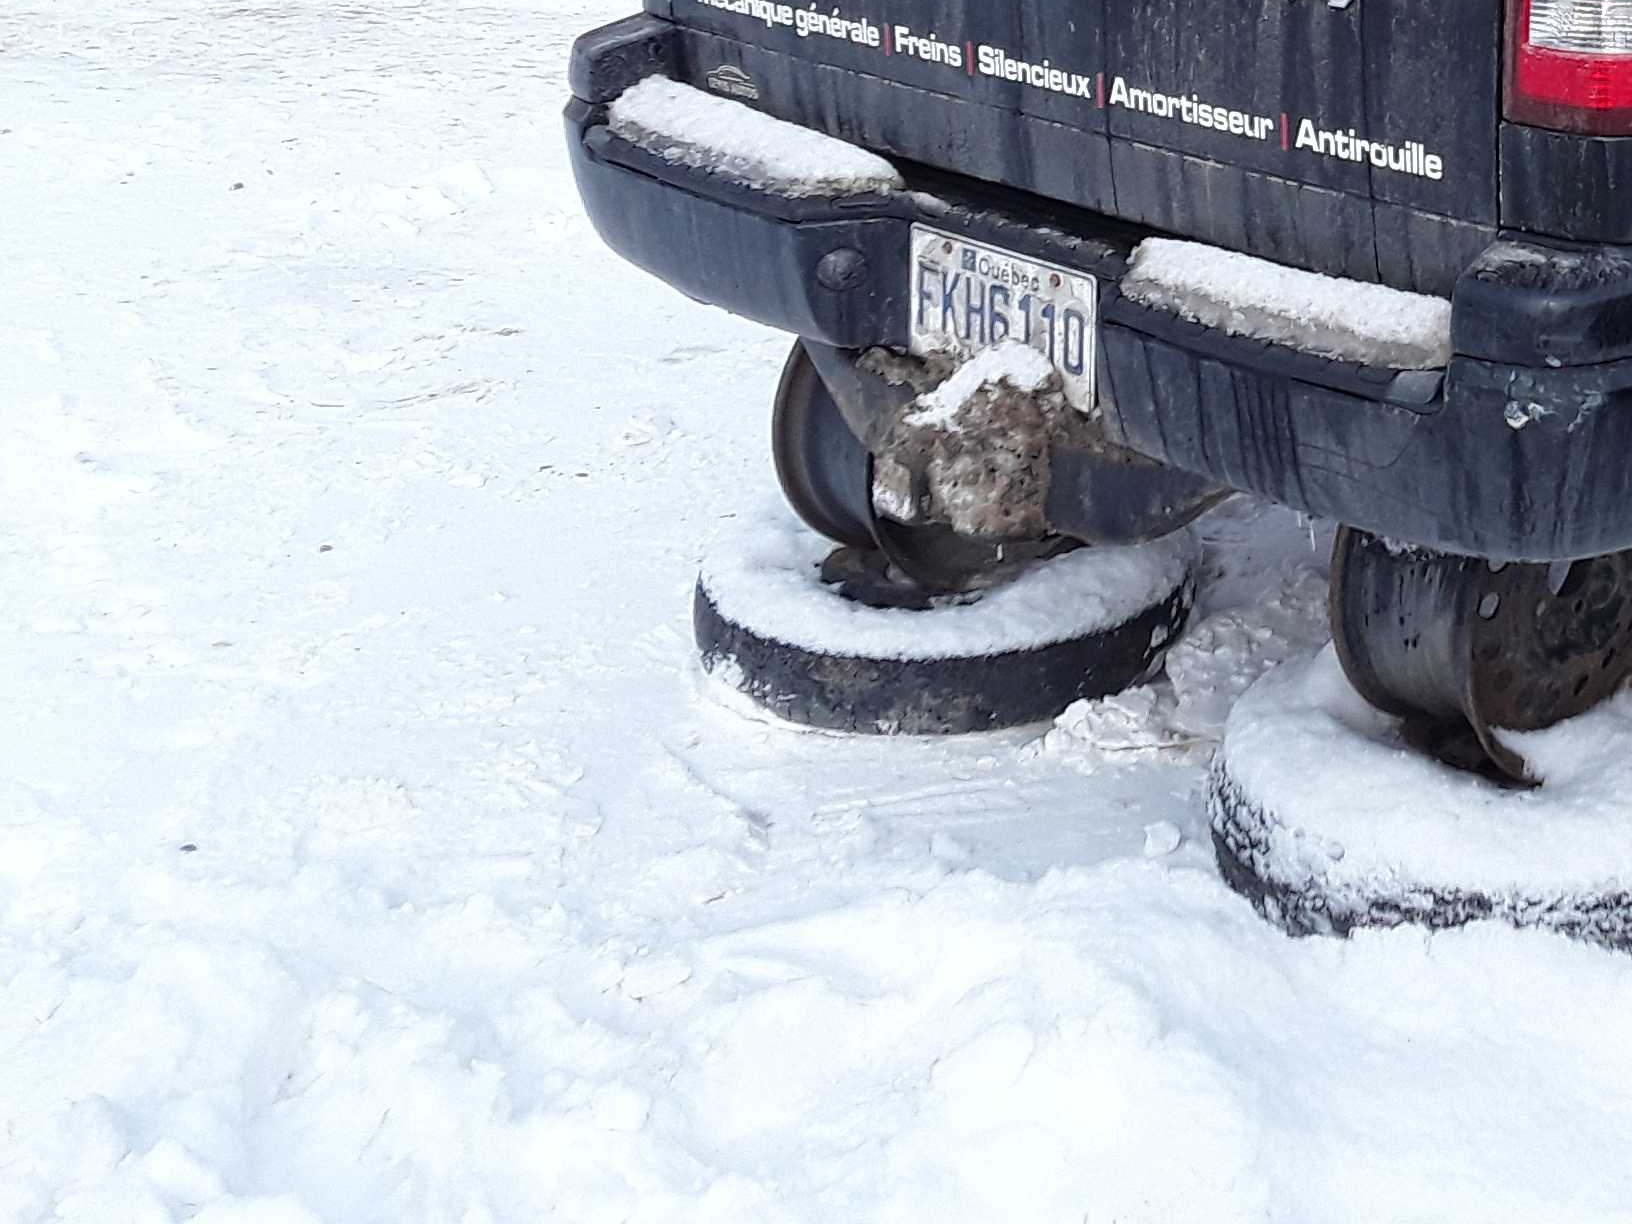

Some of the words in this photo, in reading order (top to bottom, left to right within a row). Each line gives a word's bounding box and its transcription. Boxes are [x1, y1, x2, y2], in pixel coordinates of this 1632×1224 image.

[796, 3, 880, 48] générale
[894, 26, 962, 68] Freins
[978, 45, 1091, 99] Silencieux
[1110, 76, 1274, 141] Amortisseur
[1296, 118, 1443, 181] Antirouille
[977, 253, 1041, 292] Québec
